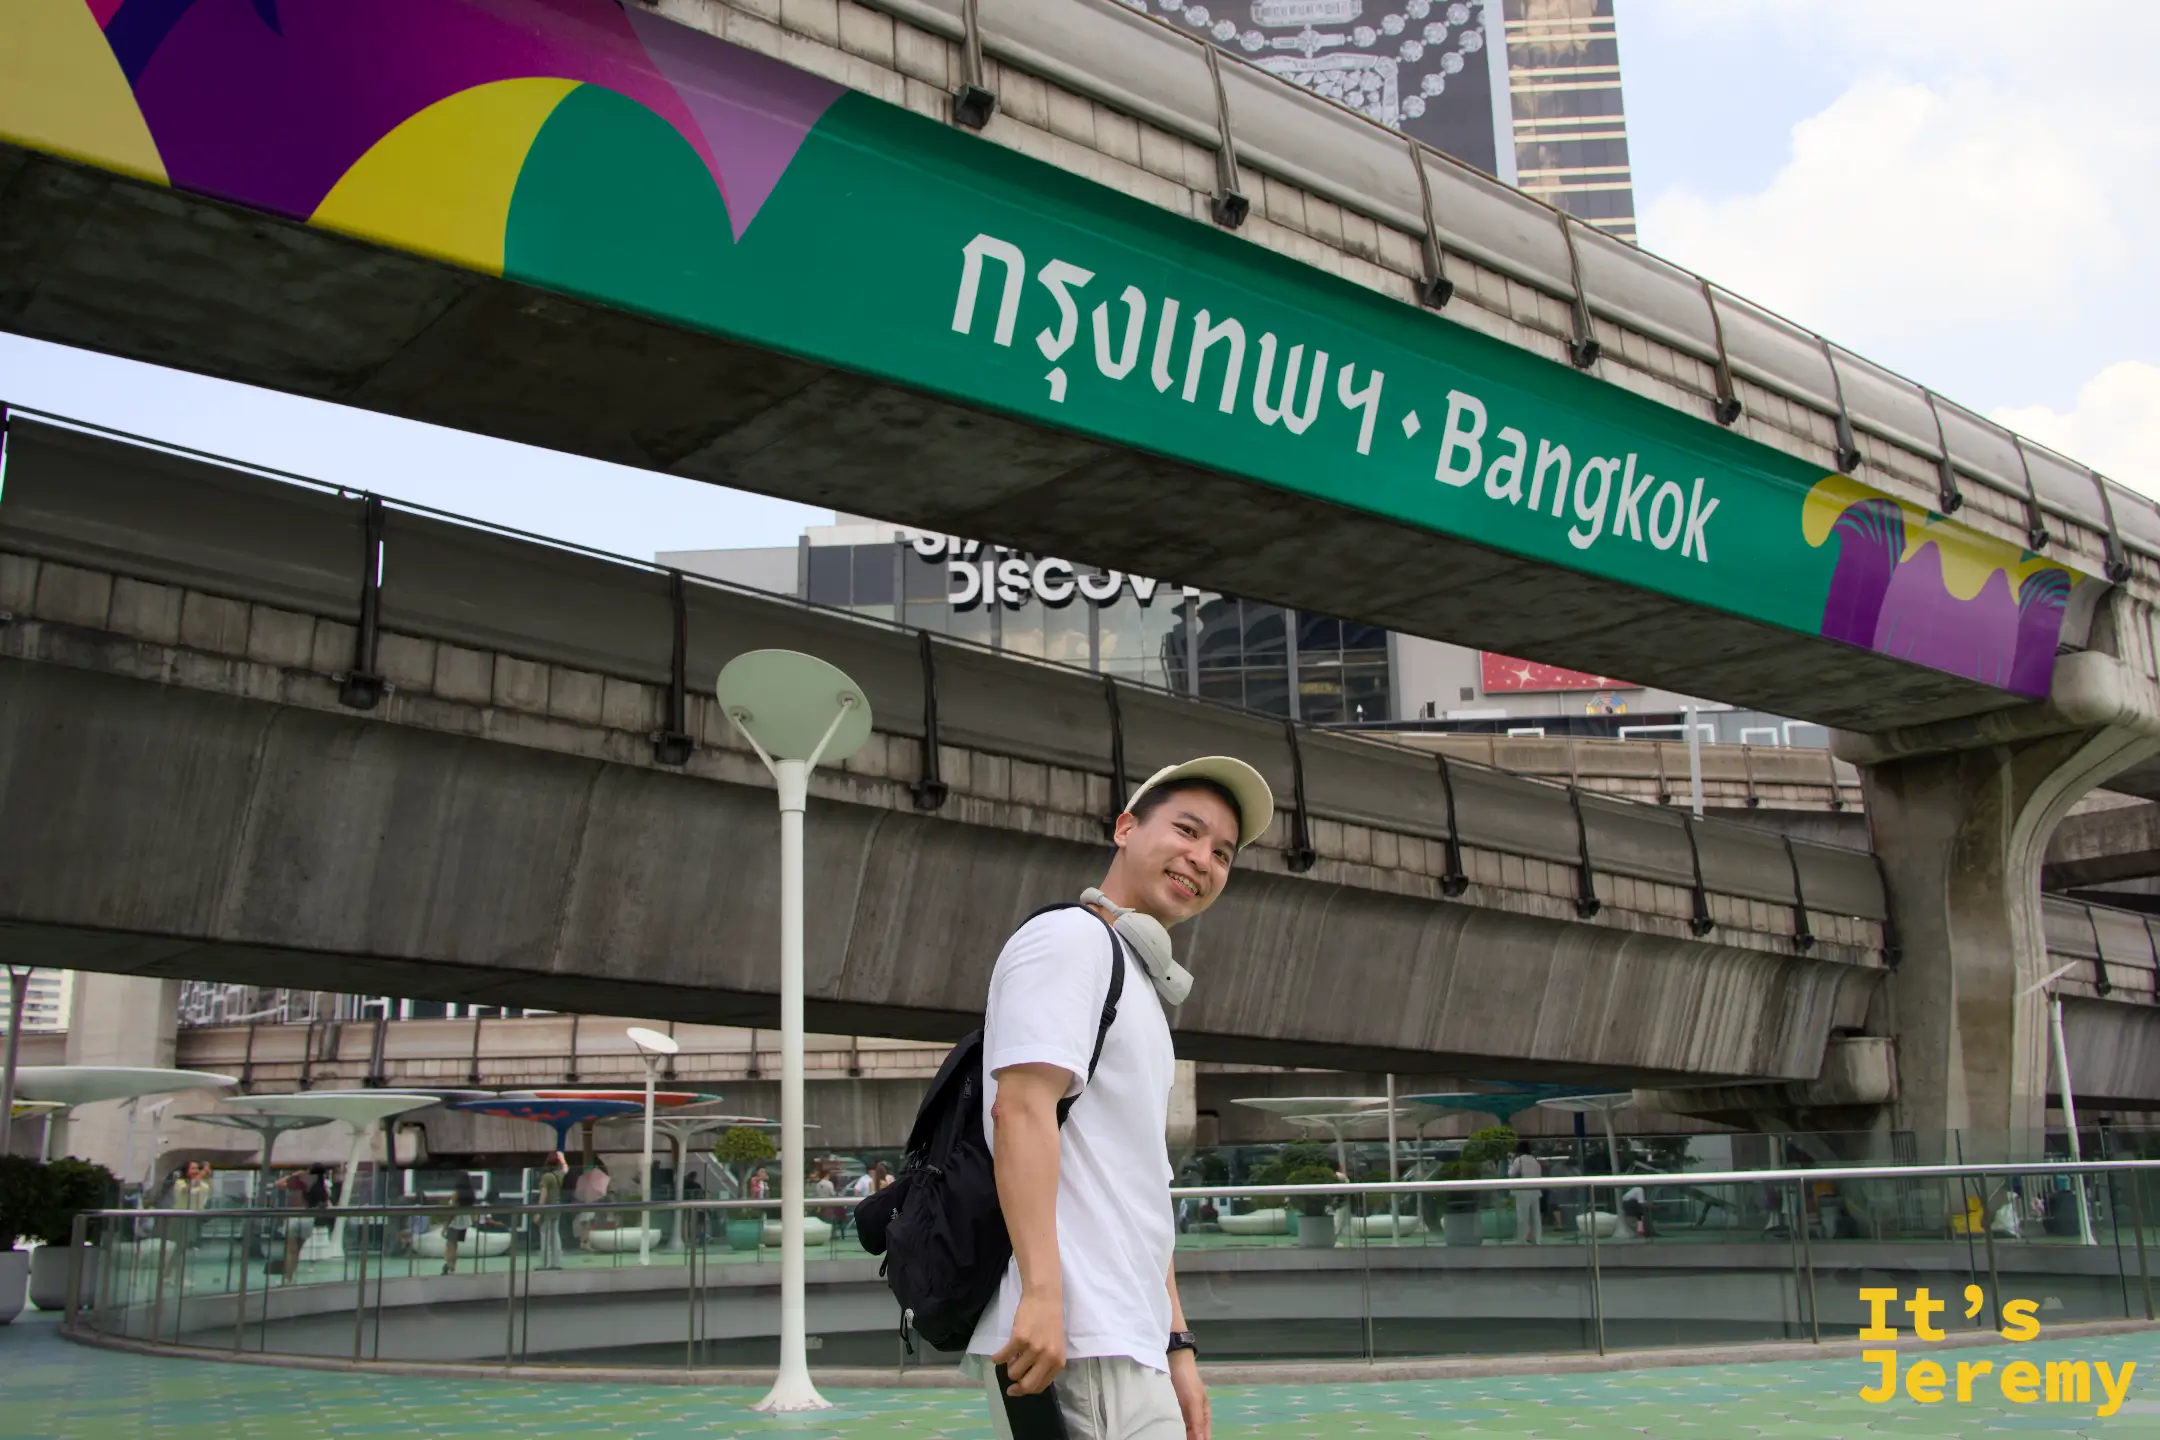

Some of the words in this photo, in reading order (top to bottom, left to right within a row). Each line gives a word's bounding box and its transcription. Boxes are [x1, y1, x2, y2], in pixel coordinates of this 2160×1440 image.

[951, 233, 1385, 456] กรุงเทพฯ
[1434, 389, 1721, 563] Bangkok
